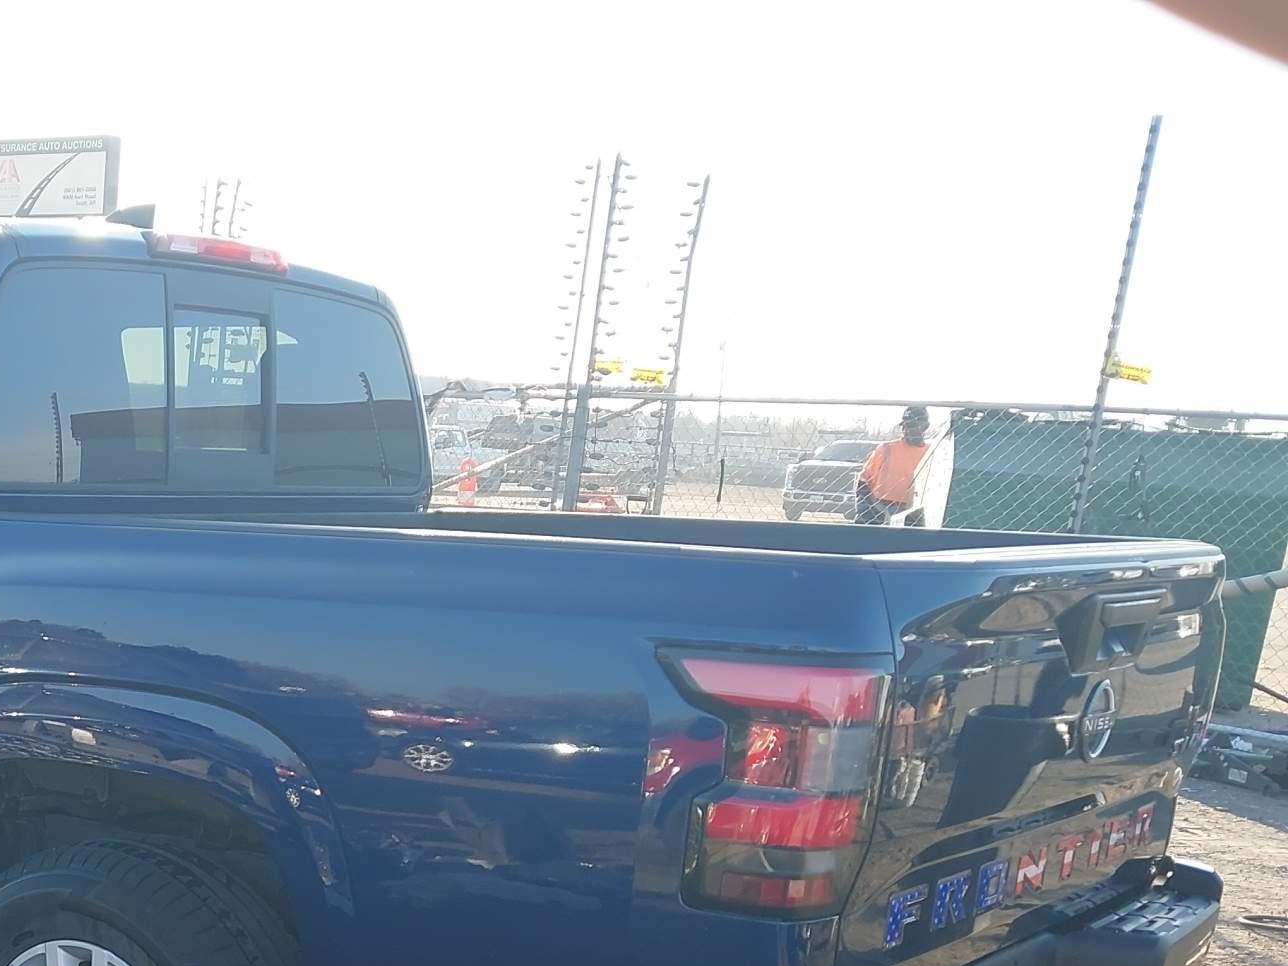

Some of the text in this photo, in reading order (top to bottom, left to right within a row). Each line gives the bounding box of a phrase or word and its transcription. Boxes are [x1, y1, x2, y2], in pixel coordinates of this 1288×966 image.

[39, 140, 60, 151] AUTO
[62, 139, 103, 150] AUCTIONS
[884, 803, 1156, 949] FRONTIER
